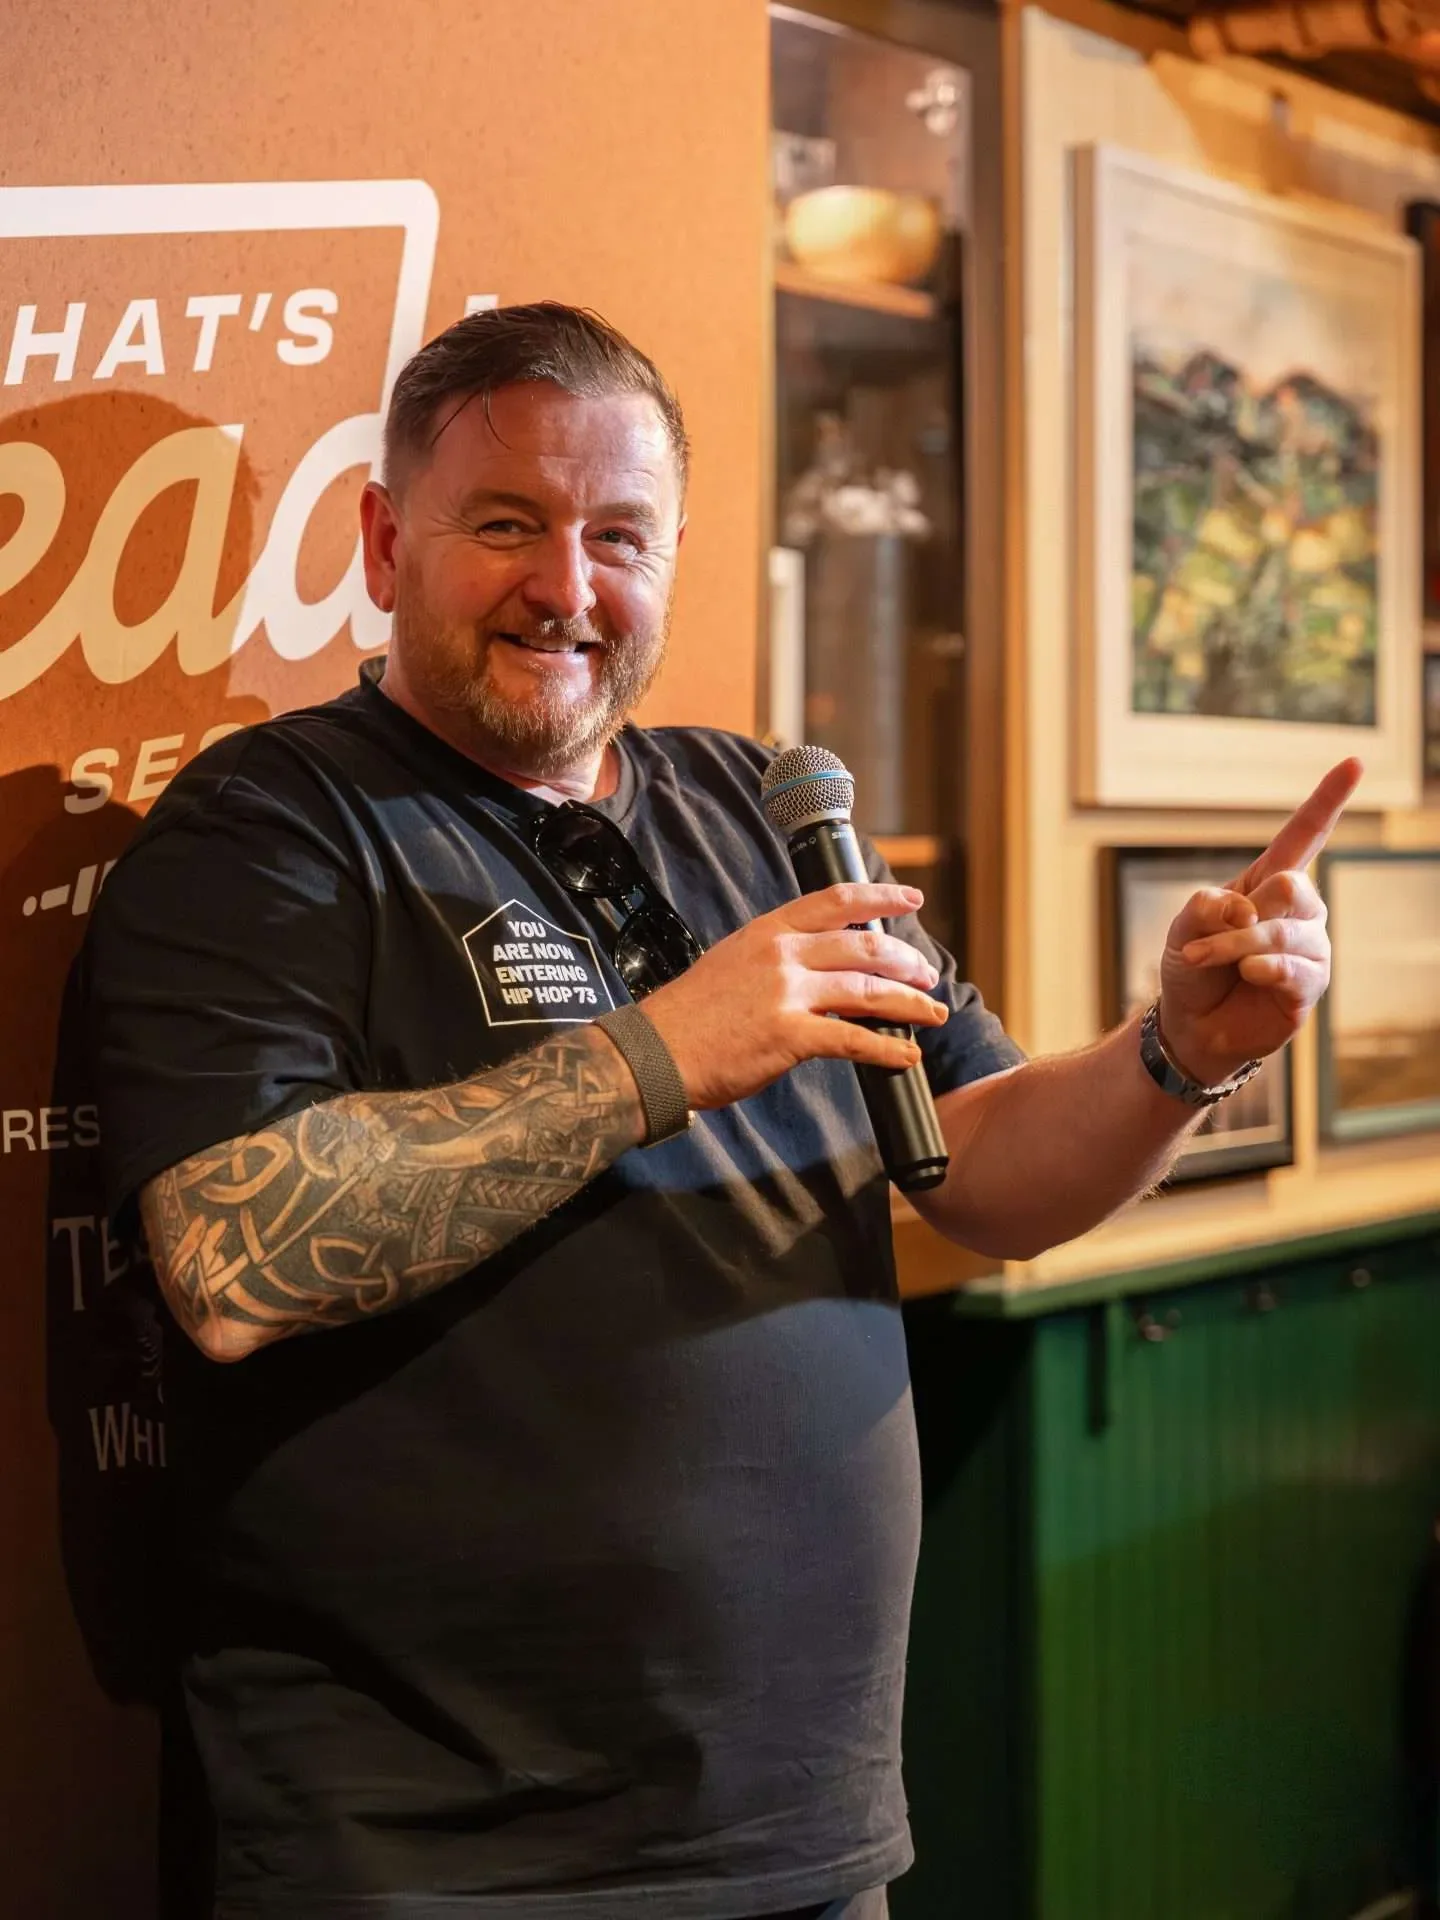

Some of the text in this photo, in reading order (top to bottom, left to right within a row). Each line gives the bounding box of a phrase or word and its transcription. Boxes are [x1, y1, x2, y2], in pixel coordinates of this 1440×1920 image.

[64, 723, 245, 814] SE
[507, 921, 546, 938] YOU
[493, 943, 575, 961] ARE NOW
[495, 964, 588, 984] ENTERING
[501, 987, 534, 1005] HIP
[534, 986, 573, 1004] HOP
